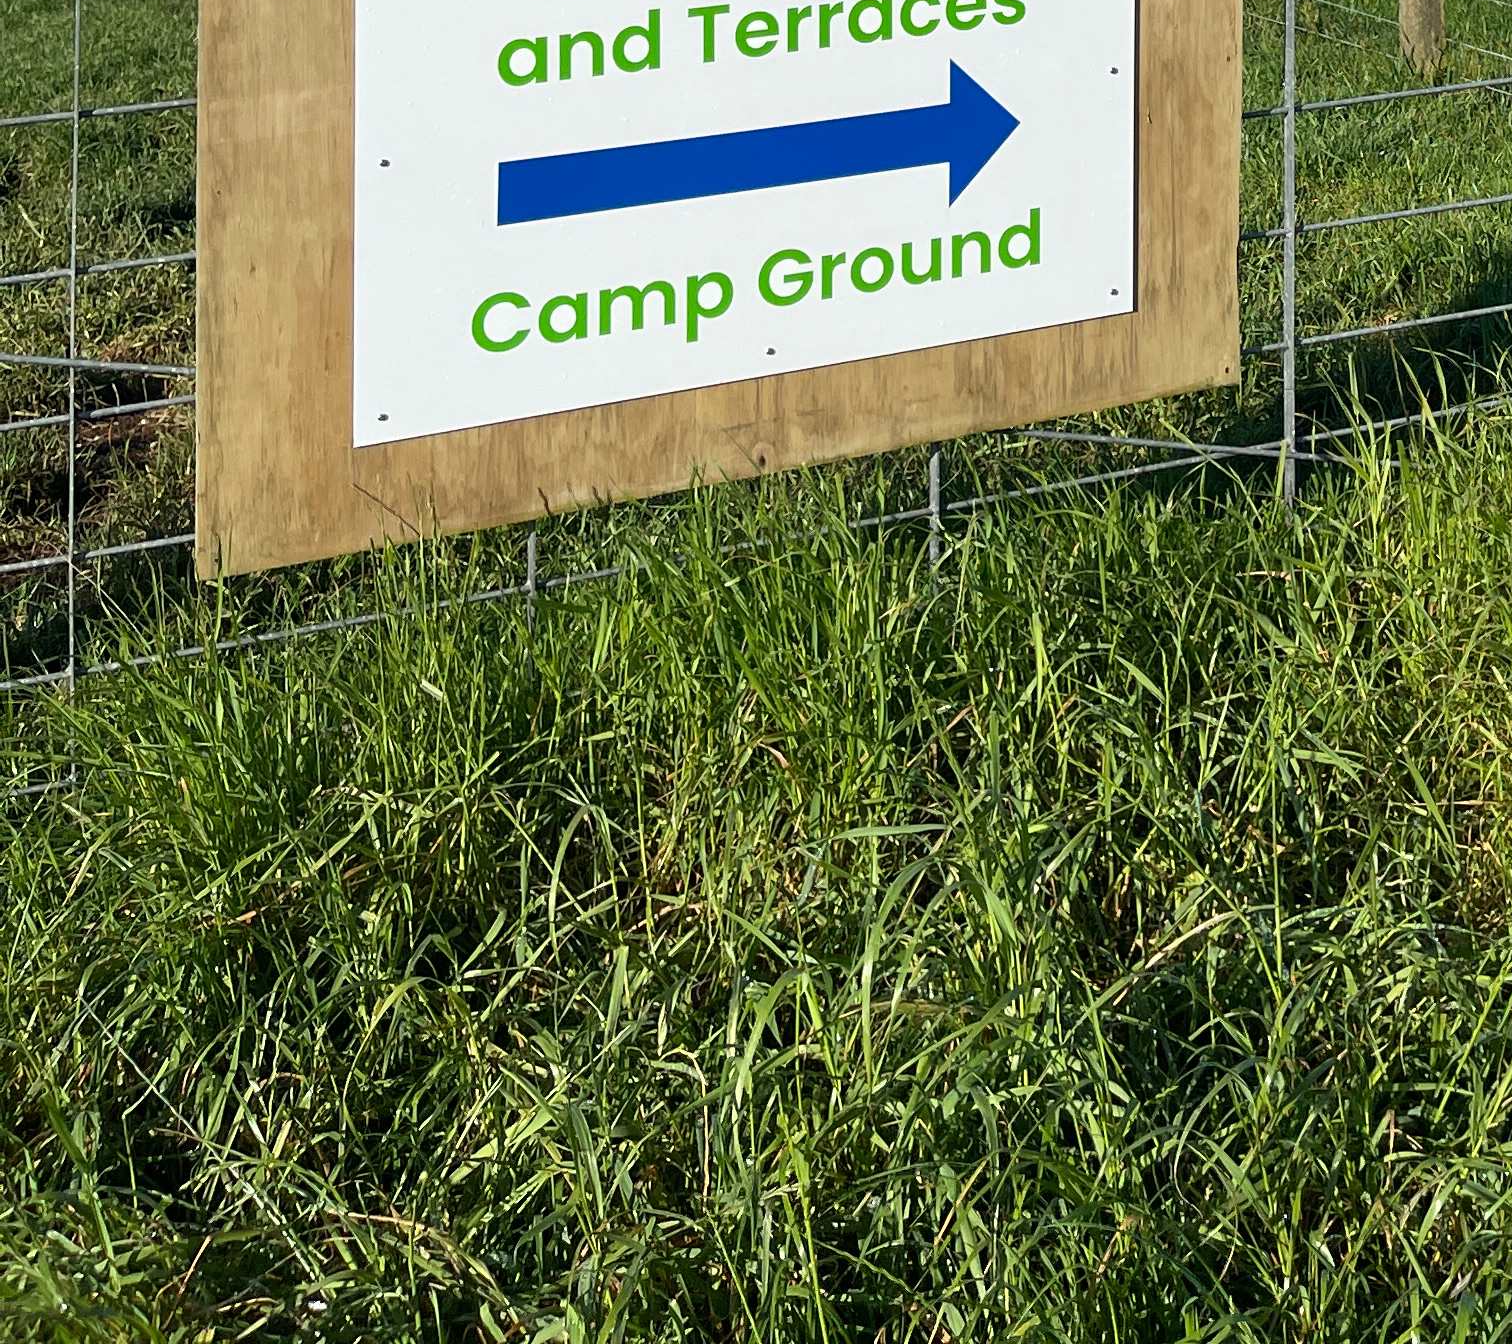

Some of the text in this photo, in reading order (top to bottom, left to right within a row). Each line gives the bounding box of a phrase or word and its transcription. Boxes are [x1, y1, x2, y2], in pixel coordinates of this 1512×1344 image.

[496, 8, 662, 87] and
[470, 207, 1041, 353] Camp Ground
